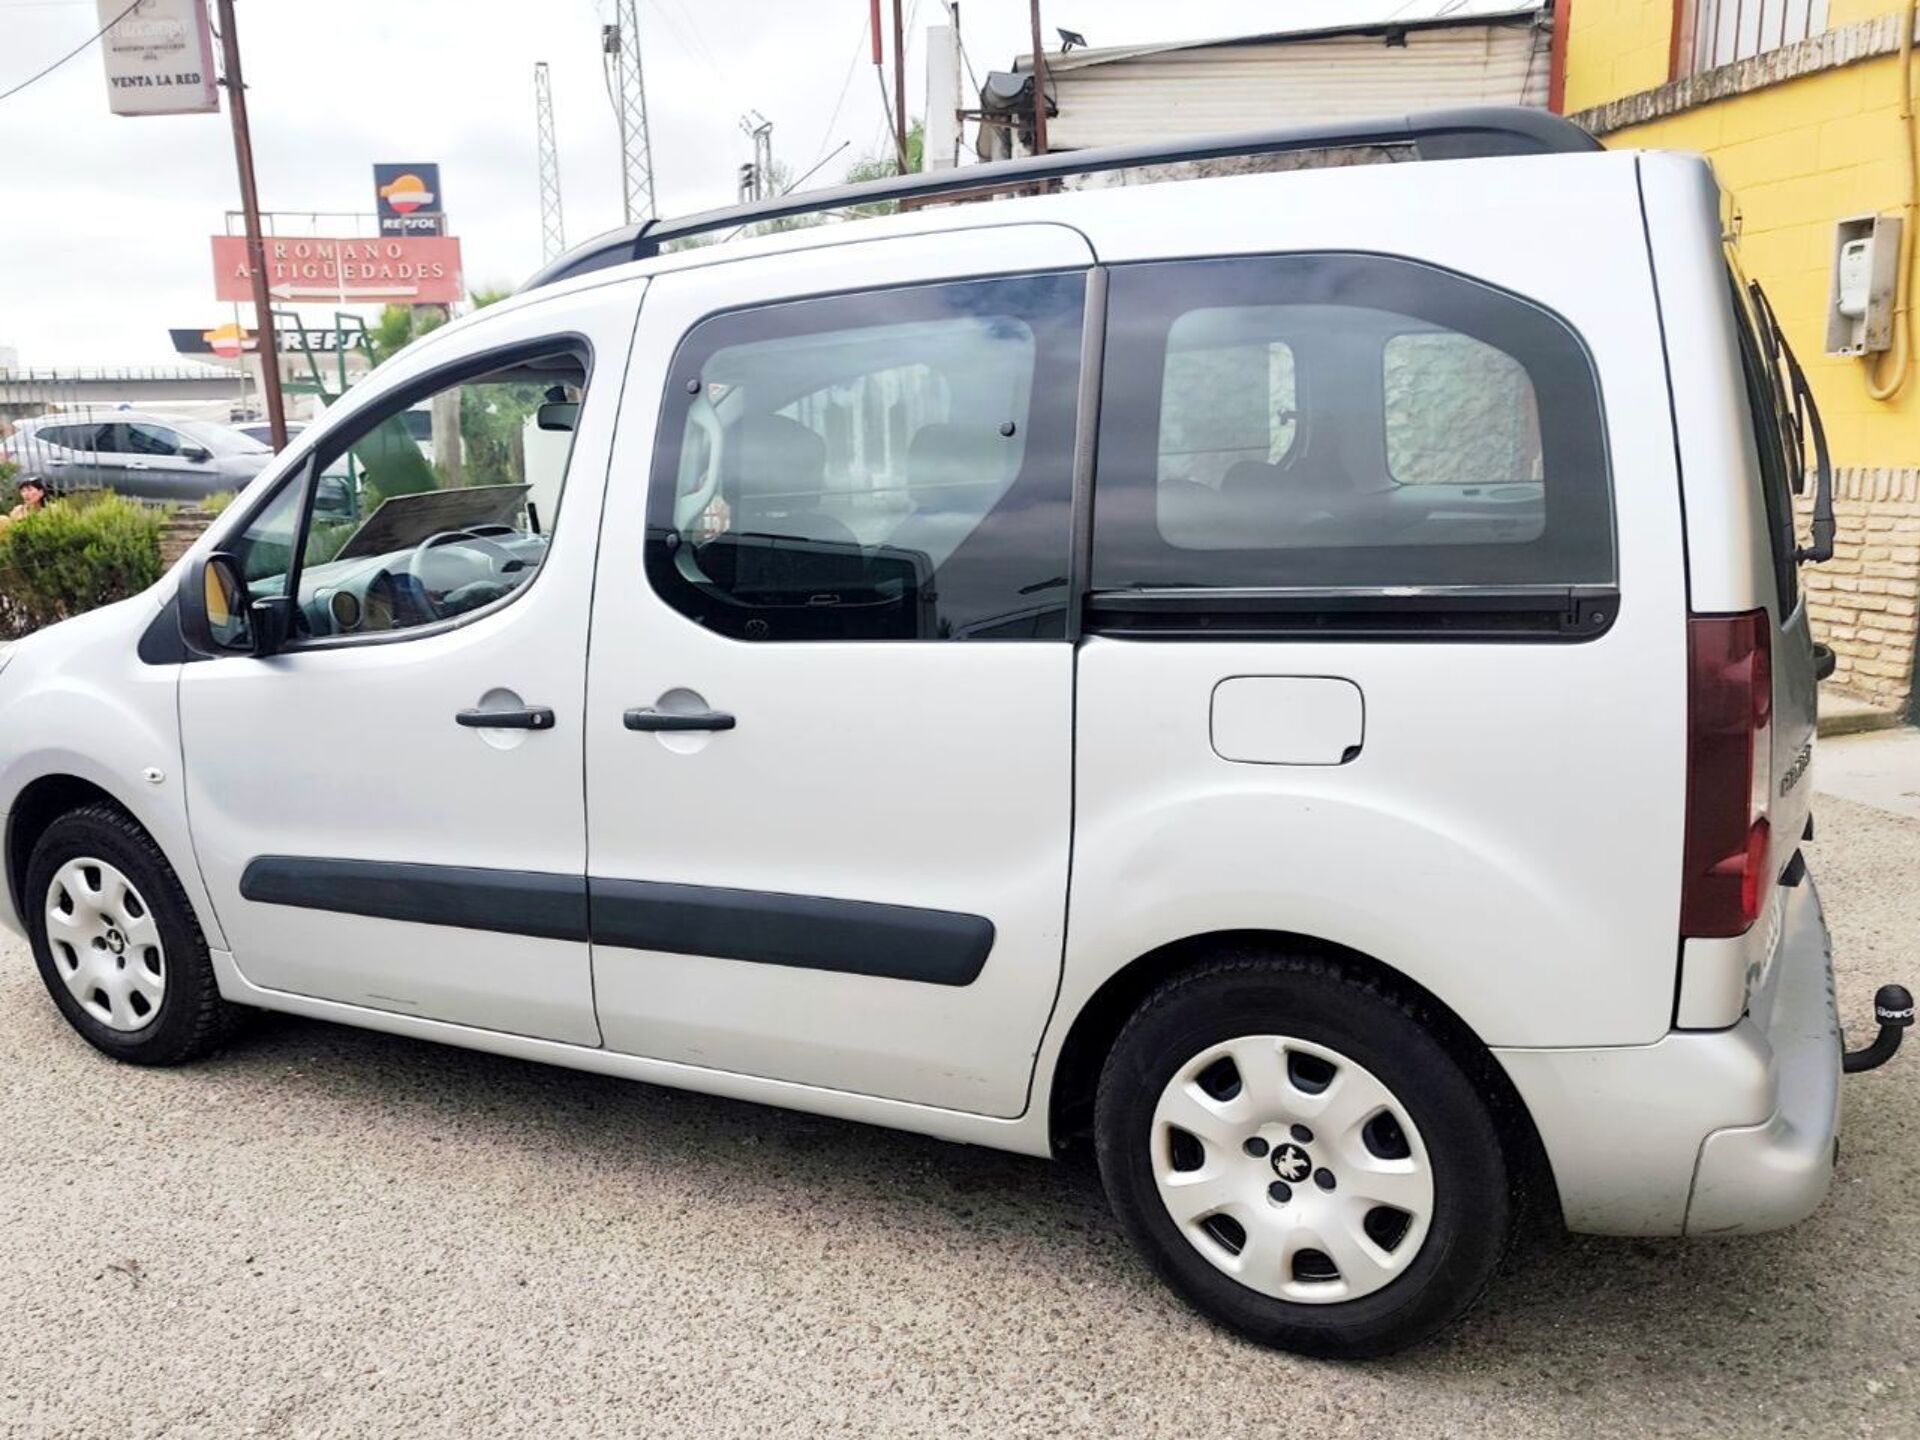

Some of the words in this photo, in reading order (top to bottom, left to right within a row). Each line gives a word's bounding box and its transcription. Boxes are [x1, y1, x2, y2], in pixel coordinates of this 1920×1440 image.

[111, 75, 153, 88] VENTA
[156, 75, 173, 87] LA
[175, 73, 201, 85] RED
[383, 218, 436, 229] REPSOL
[274, 243, 402, 259] ROMANO
[235, 261, 444, 279] ATIGÜEDADES
